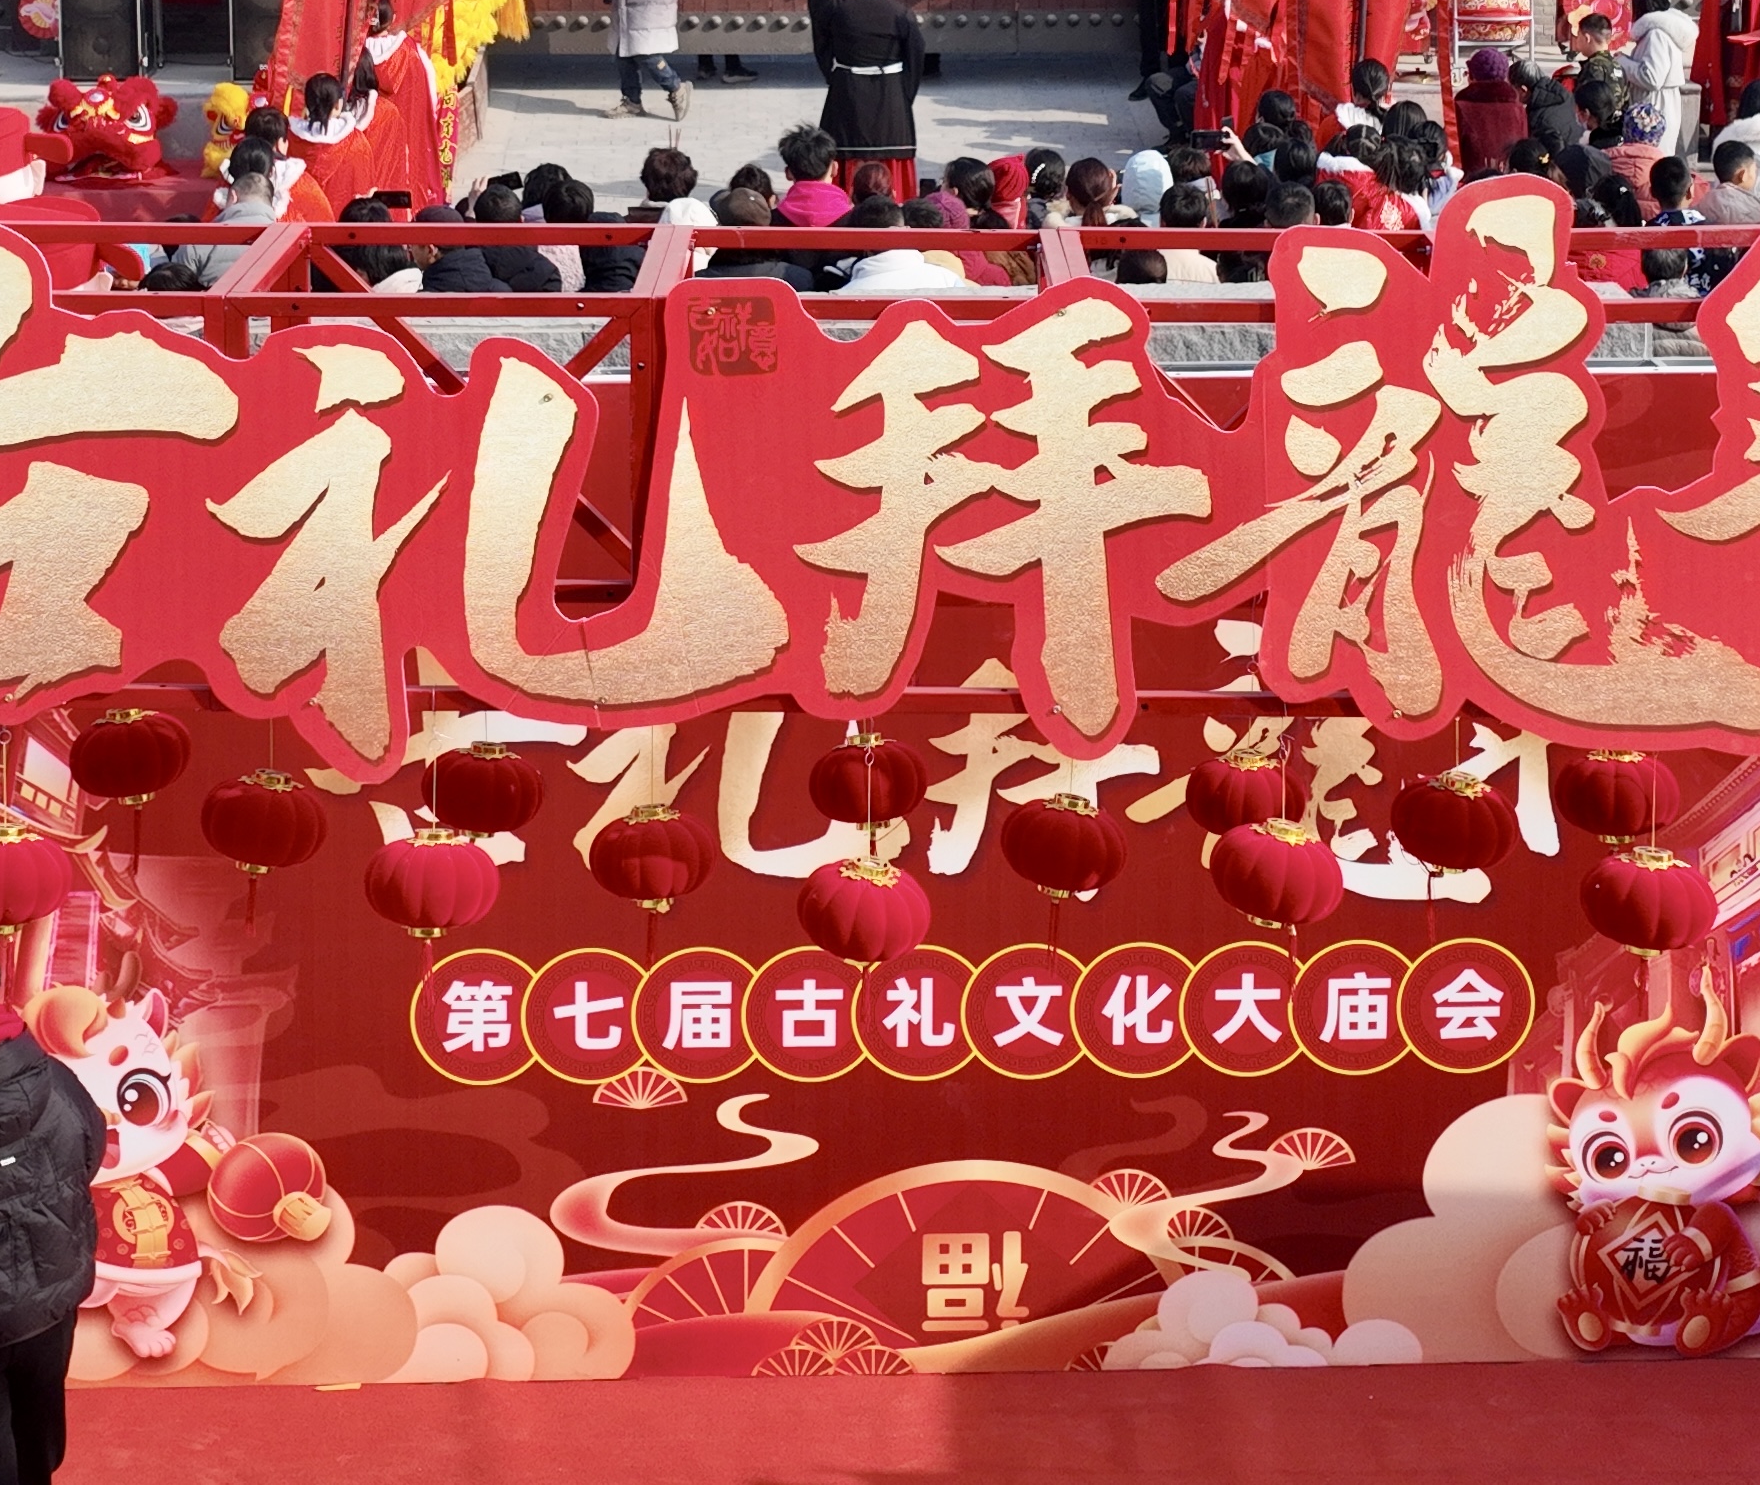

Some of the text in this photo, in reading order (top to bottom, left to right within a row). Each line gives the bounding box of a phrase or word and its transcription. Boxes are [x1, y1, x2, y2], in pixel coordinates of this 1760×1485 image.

[441, 967, 1505, 1055] 第七届古礼文化大庙会
